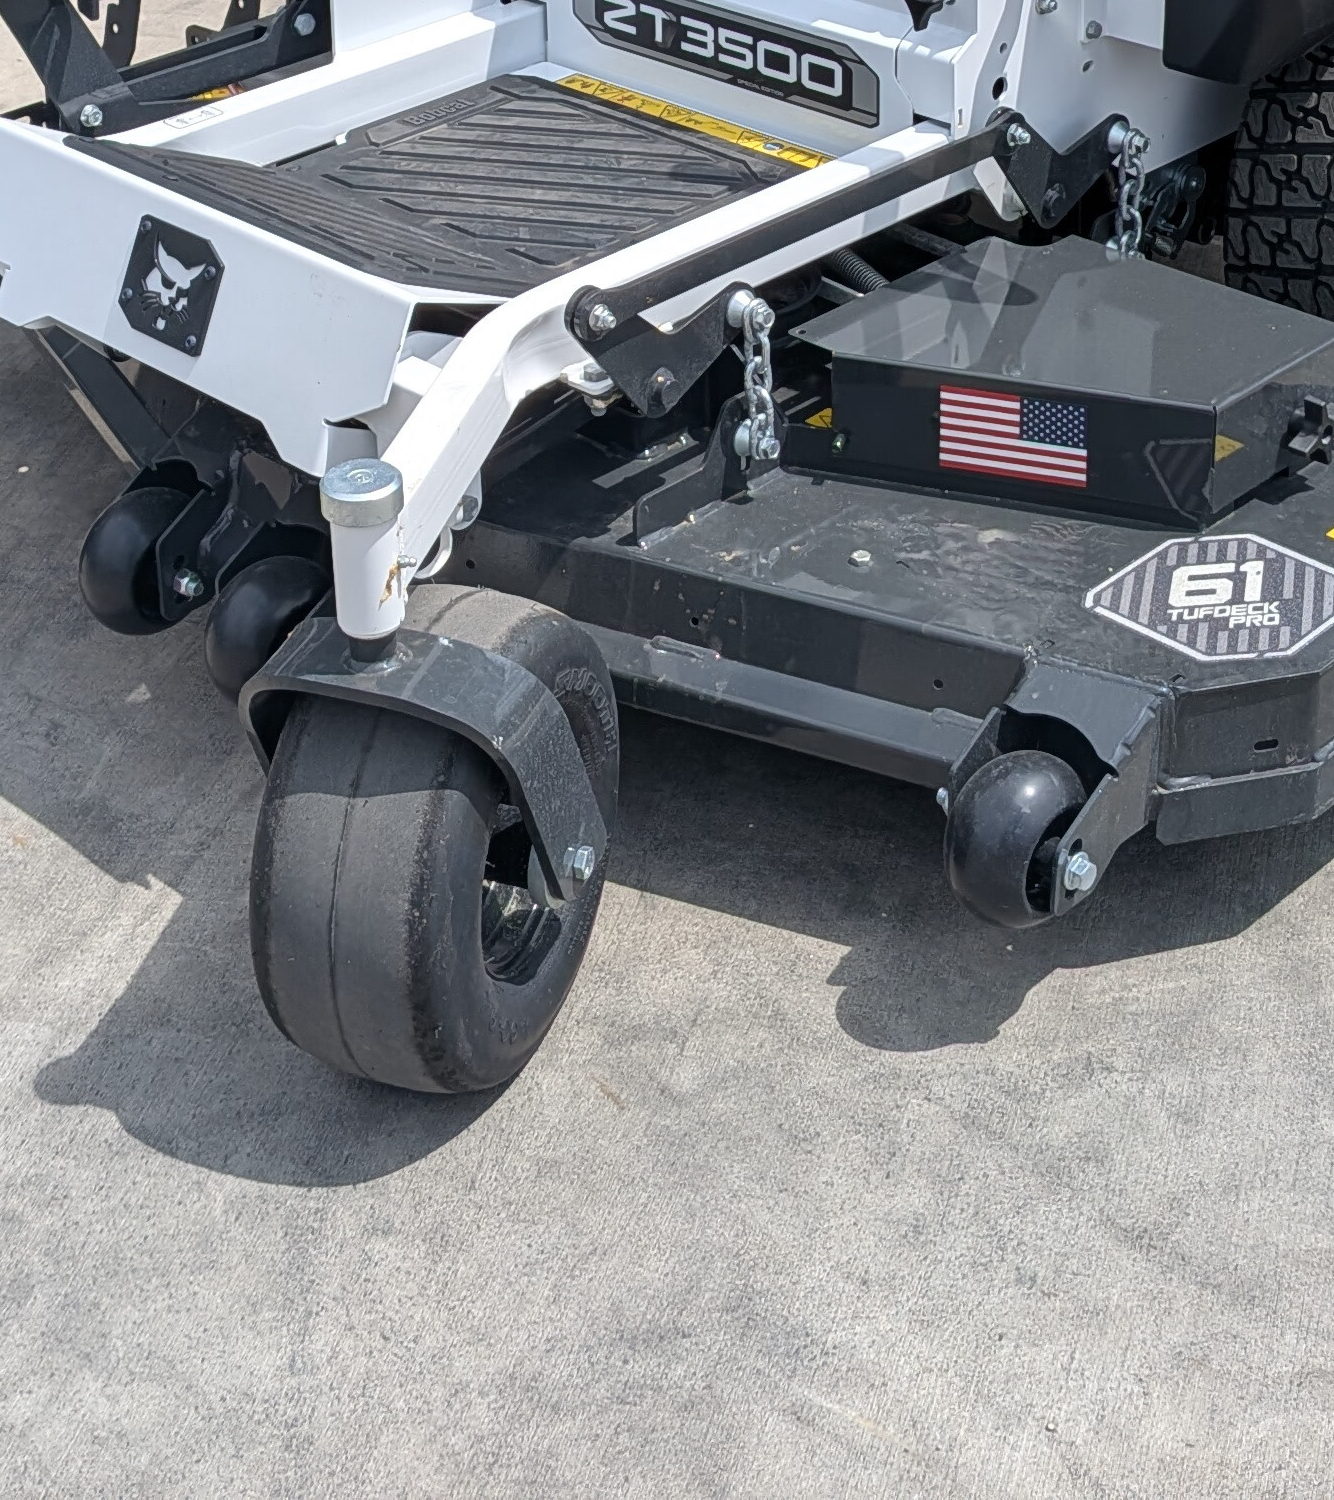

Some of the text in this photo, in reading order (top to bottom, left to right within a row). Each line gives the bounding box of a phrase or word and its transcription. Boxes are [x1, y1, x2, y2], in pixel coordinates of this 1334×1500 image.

[403, 98, 476, 126] Bobcat
[1168, 560, 1265, 608] 61
[1167, 601, 1281, 622] TUFDECK
[1228, 613, 1281, 629] PRO
